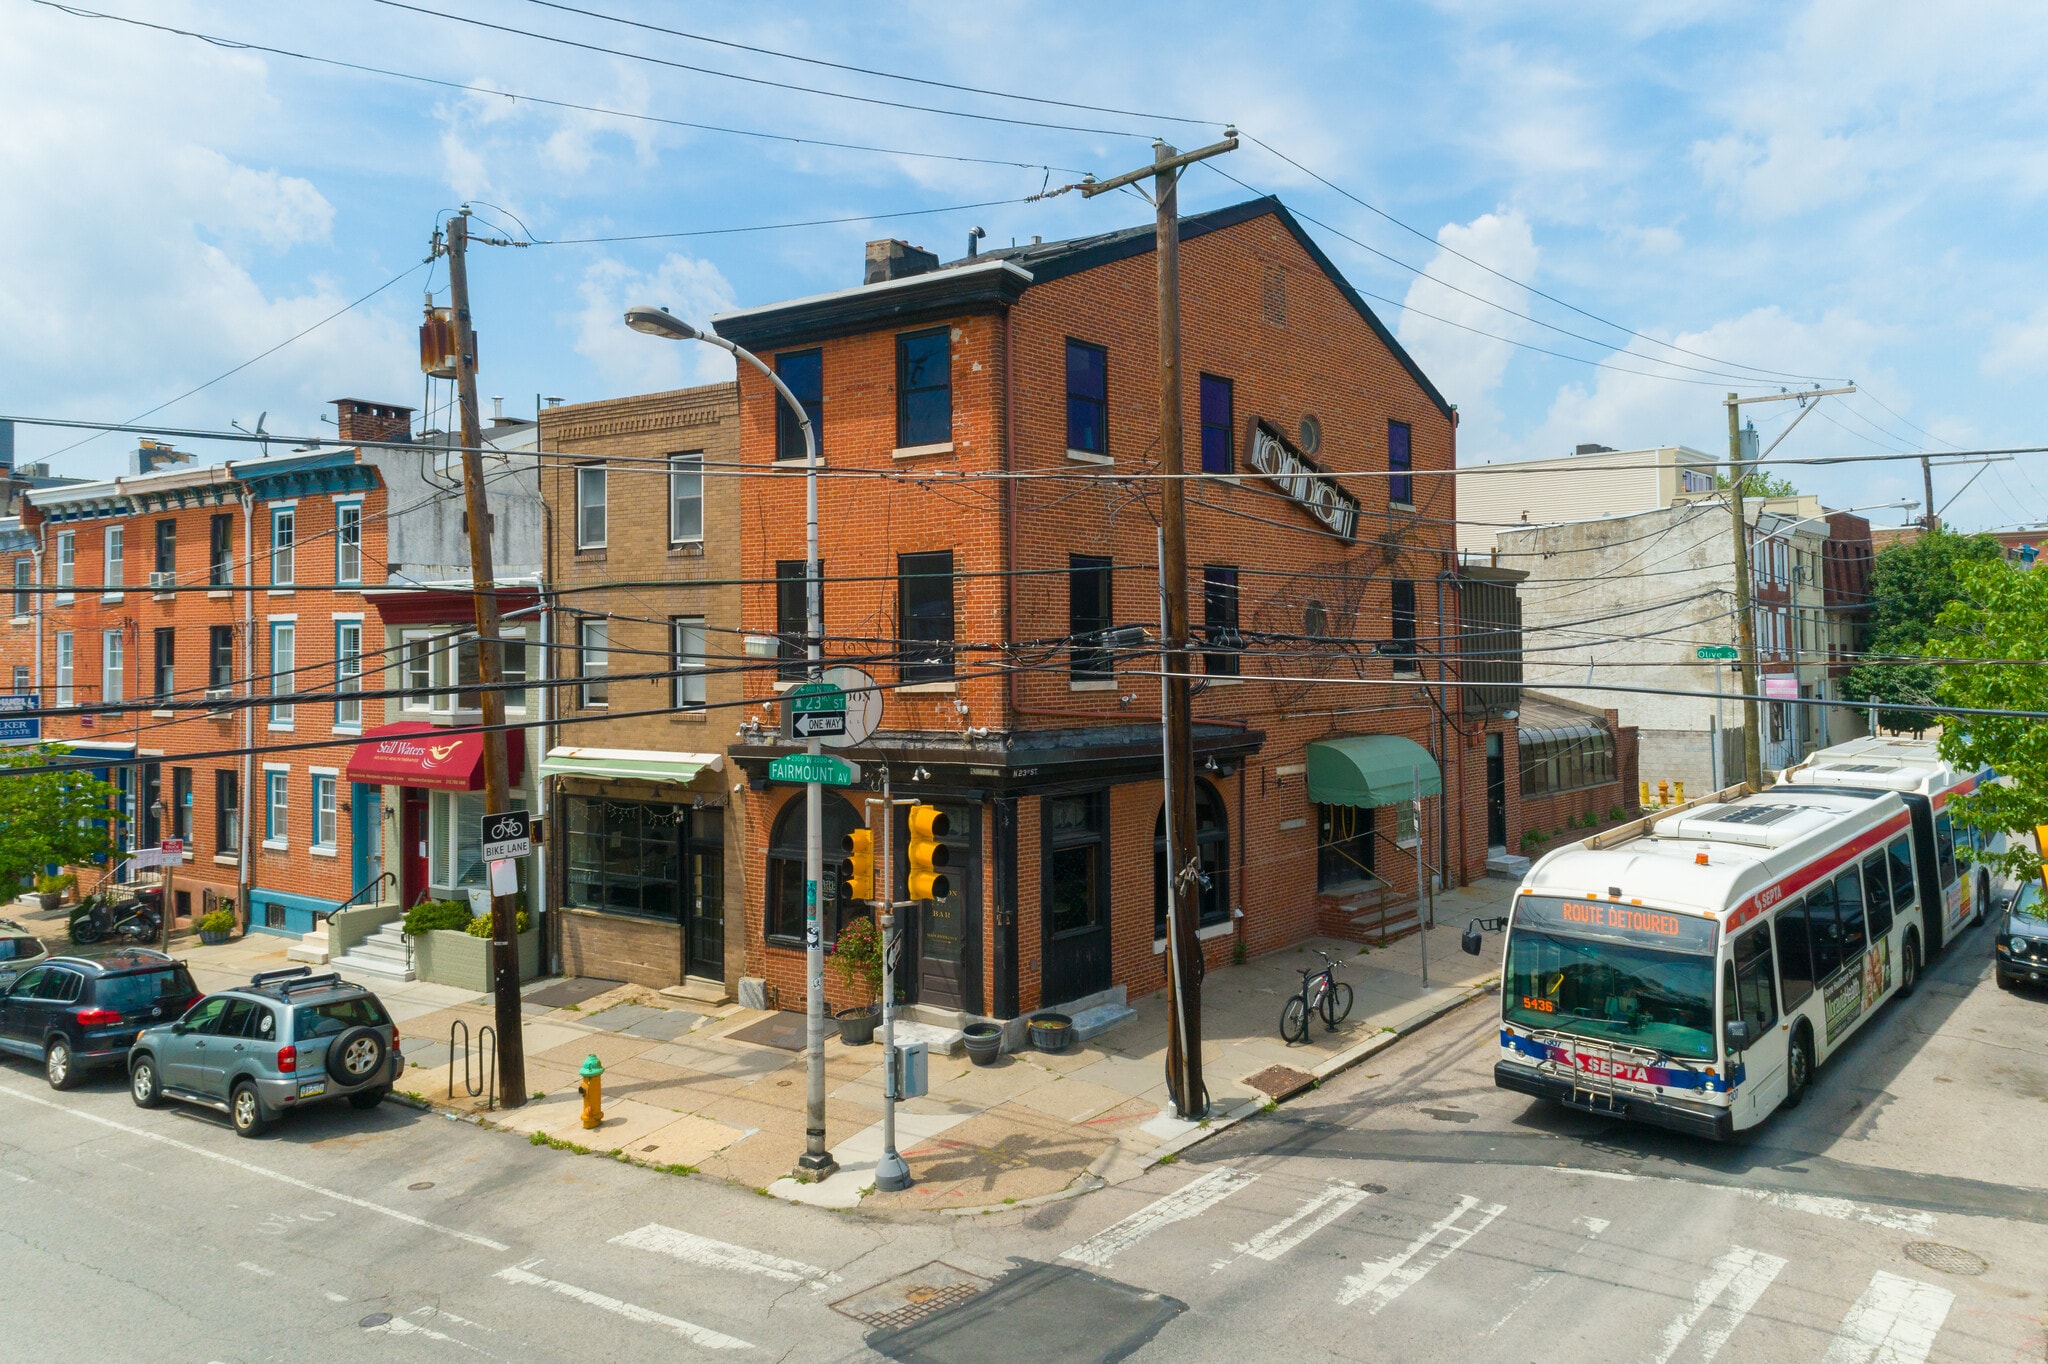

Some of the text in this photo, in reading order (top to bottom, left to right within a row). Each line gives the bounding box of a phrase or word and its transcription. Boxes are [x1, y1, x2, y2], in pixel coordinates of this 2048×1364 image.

[1698, 650, 1722, 658] Olive
[833, 698, 844, 709] ST
[808, 717, 841, 731] ONE WAY
[377, 741, 425, 755] Still Waters
[771, 763, 848, 783] FAIRMOUNT AV
[486, 842, 527, 856] BIKE LANE
[1762, 885, 1782, 907] SEPTA
[933, 910, 951, 918] BAR
[1563, 902, 1679, 935] ROUTE DETOURED
[1523, 997, 1553, 1012] 5436
[1587, 1060, 1649, 1082] SEPTA
